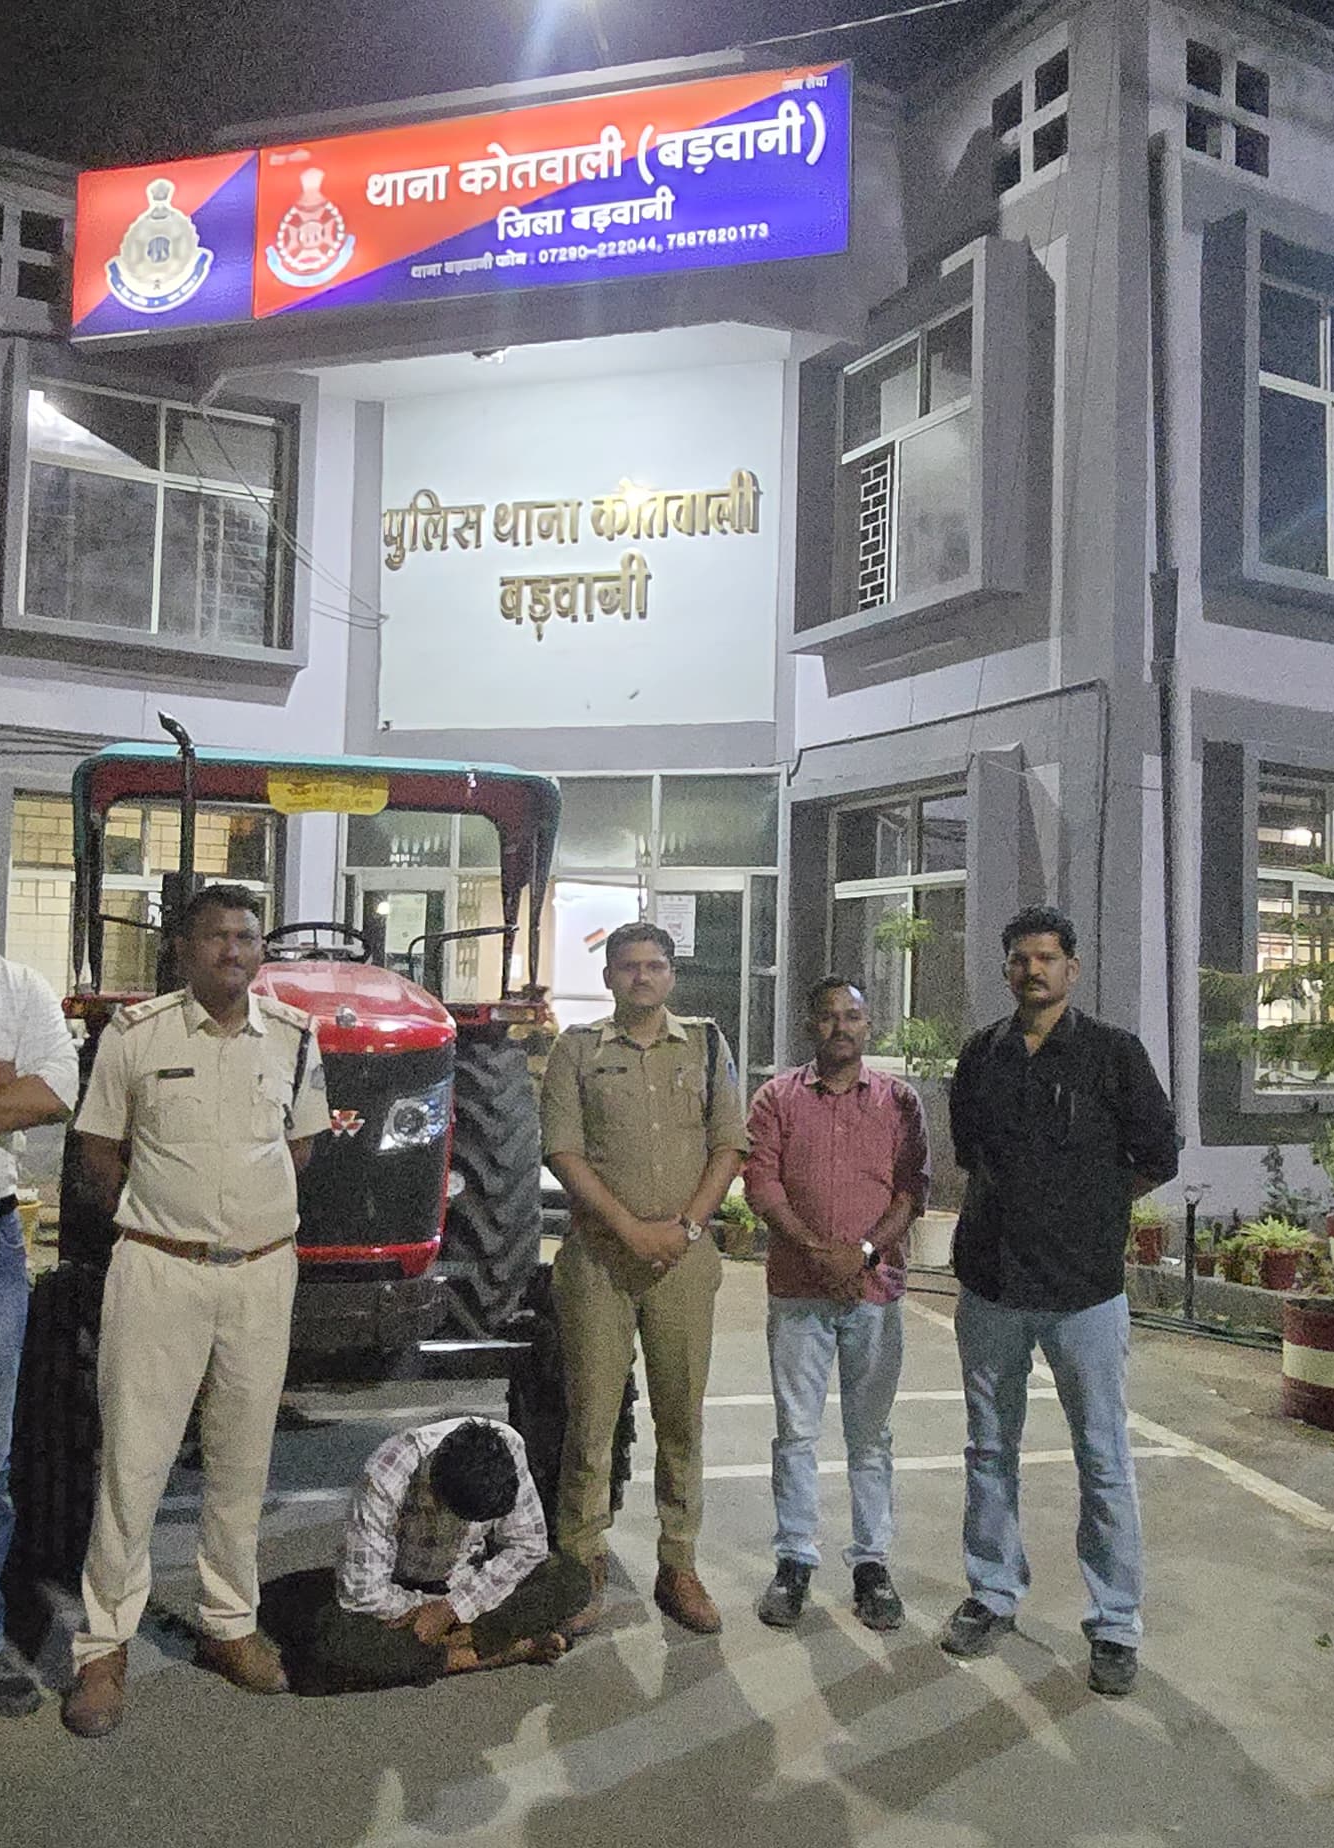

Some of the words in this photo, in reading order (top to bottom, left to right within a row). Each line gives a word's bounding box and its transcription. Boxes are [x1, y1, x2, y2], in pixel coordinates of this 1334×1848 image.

[366, 165, 451, 207] थाना
[458, 125, 626, 195] कोतवाली
[637, 99, 827, 186] (बड़वानी)
[496, 206, 565, 241] जिला
[571, 185, 676, 234] बड़वानी
[381, 488, 486, 571] पुलिस
[493, 500, 583, 548] थाना
[591, 468, 763, 541] कोतवाली
[499, 547, 652, 642] बड़वानी
